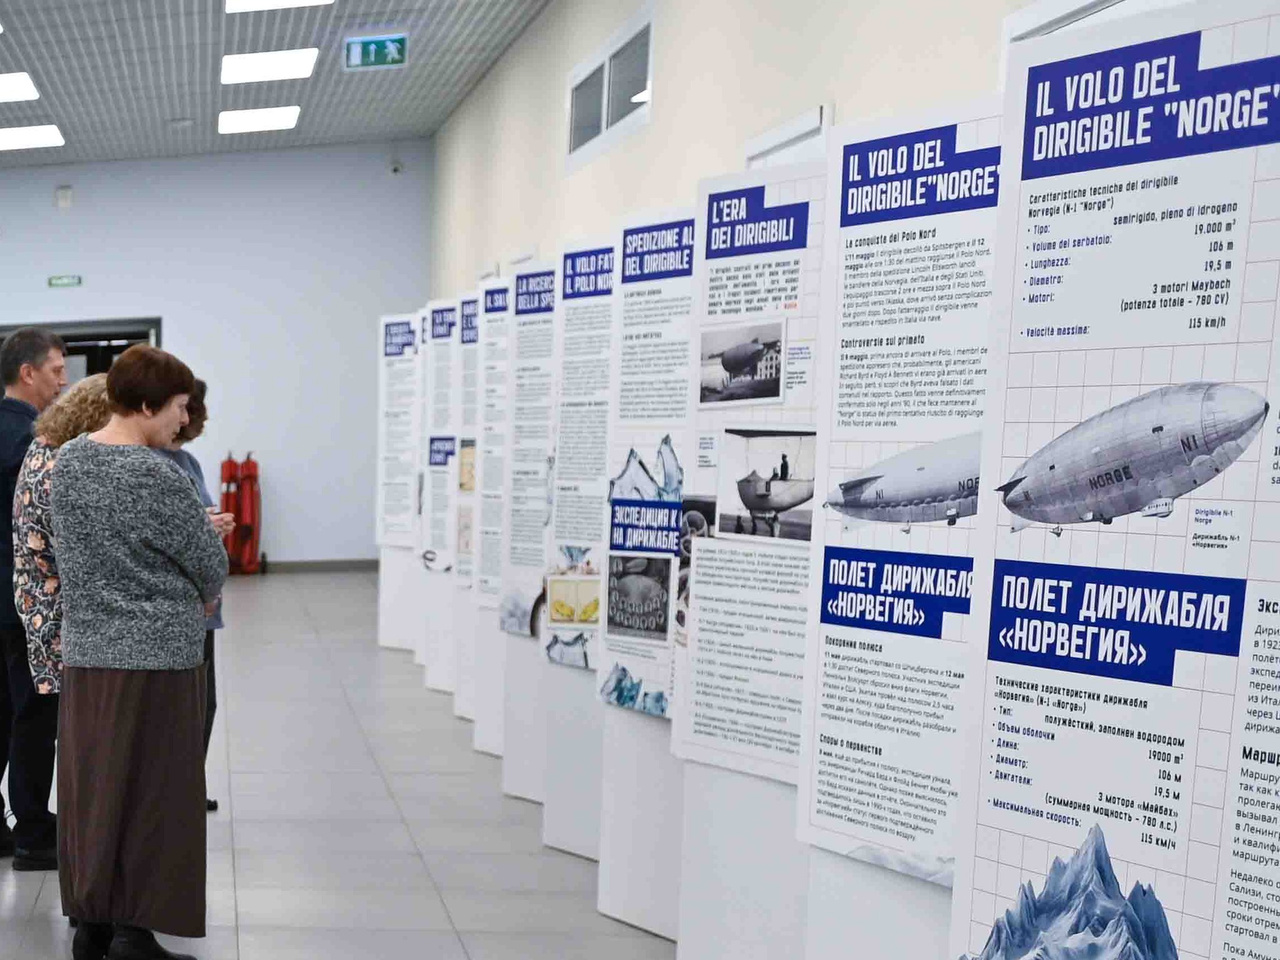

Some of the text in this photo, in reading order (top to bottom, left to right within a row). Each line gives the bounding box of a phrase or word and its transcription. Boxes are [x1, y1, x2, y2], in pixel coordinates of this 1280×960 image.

[1036, 55, 1180, 117] IL VOLO DEL
[1033, 106, 1154, 161] DIRIGIBILE
[849, 139, 944, 182] IL VOLO DEL
[847, 177, 926, 215] DIRIGIBILE
[1030, 175, 1179, 204] Caratteristiche tecniche del dirigibile
[712, 197, 747, 224] L'ERA
[1028, 205, 1060, 218] Norvegia
[1063, 203, 1077, 215] (N-1
[1034, 202, 1237, 235] Tipo: semirigido, pieno di idrogeno
[626, 226, 694, 253] SPEDIZIONE AL
[711, 217, 794, 250] DEI DIRIGIBILI
[889, 232, 899, 243] del
[902, 231, 916, 241] Polo
[919, 227, 936, 239] Nord
[1033, 241, 1056, 252] Volume
[1059, 238, 1070, 249] del
[1072, 235, 1113, 247] serbatoio:
[1195, 222, 1222, 235] 19.000
[566, 258, 574, 275] IL
[576, 255, 597, 273] VOLO
[624, 249, 690, 277] DEL DIRIGIBILE
[1031, 241, 1234, 269] Lunghezza: 106 m
[565, 274, 595, 294] IL POLO
[1029, 260, 1232, 286] Diametro: 19,5 m
[1028, 279, 1231, 303] Motori: 3 motori Maybach
[1120, 292, 1229, 312] (potenza totale 780 CV)
[1026, 316, 1226, 337] Velocità massima: 115 km/h
[841, 334, 924, 349] Controversie sul primato
[1089, 465, 1133, 491] NORGE
[614, 505, 678, 528] ЭКСПЕДИЦИЯ К
[1195, 517, 1212, 525] Norge
[613, 527, 679, 550] НА ДИРИЖАБЛЕ
[1192, 533, 1228, 541] Дирижабль
[829, 559, 974, 599] ПОЛЕТ ДИРИЖАБЛЯ
[827, 591, 925, 626] «НОРВЕГИЯ»
[1001, 574, 1231, 632] ПОЛЕТ ДИРИЖАБЛЯ
[859, 641, 883, 653] полюса
[998, 617, 1148, 666] «НОРВЕГИЯ»
[994, 689, 1034, 703] «Норвегия»
[995, 675, 1148, 709] Технические характеристики дирижабля
[1248, 695, 1258, 703] из
[999, 705, 1013, 716] Тип:
[1098, 724, 1135, 739] заполнен
[1137, 731, 1185, 747] водородом
[1247, 708, 1273, 720] через
[820, 733, 838, 746] Споры
[846, 740, 882, 756] первенстве
[998, 721, 1171, 763] Объем оболочки 19000
[996, 737, 1182, 783] Длина: 106 м
[996, 754, 1180, 800] Диаметр: 19,5 м
[1239, 782, 1272, 796] так как
[995, 770, 1179, 818] Двигатели: 3 мотора «Майбах»
[1045, 792, 1090, 812] (суммарная
[1093, 805, 1132, 822] мощность
[1143, 816, 1156, 828] 780
[1236, 809, 1278, 824] вызывал
[993, 798, 1176, 850] Максимальная скорость: 115 км/ч
[1233, 850, 1279, 866] маршрута
[1229, 882, 1263, 899] Сализи,
[1231, 868, 1273, 887] Недалеко
[1226, 910, 1253, 923] сроки
[1225, 923, 1270, 941] стартовал
[1223, 942, 1245, 956] Пока
